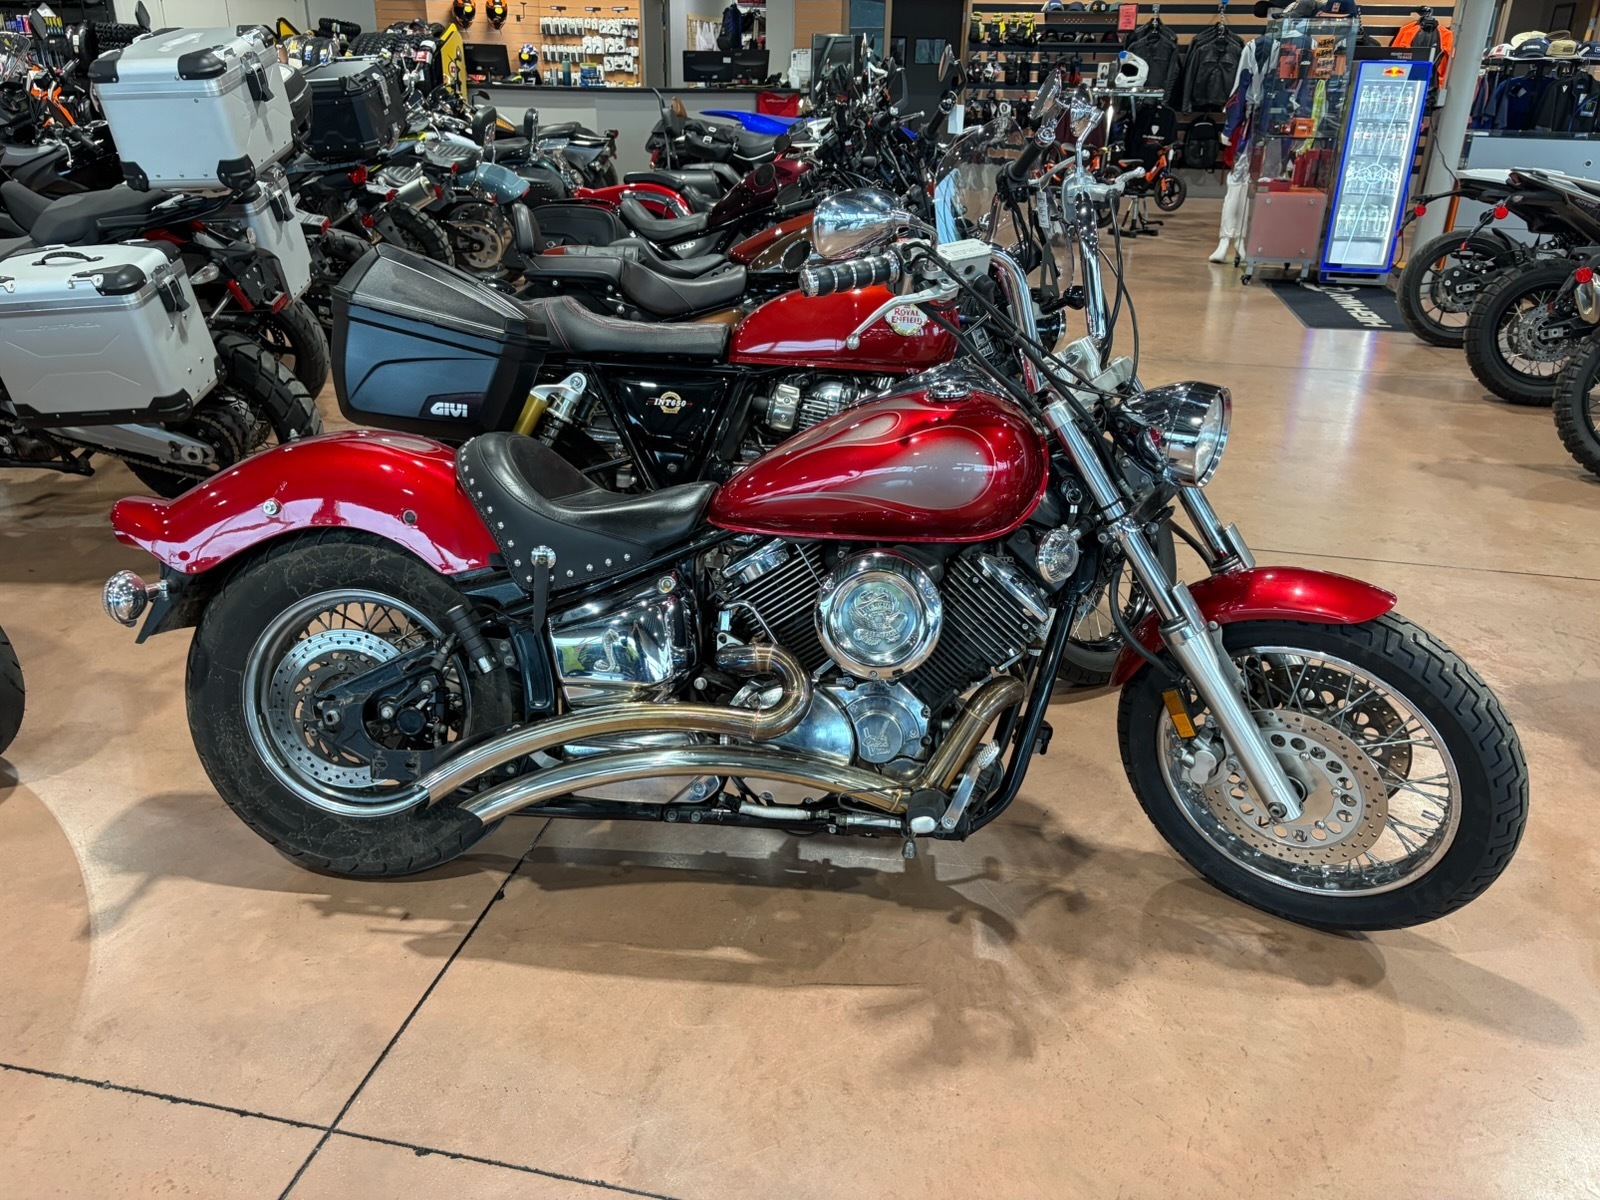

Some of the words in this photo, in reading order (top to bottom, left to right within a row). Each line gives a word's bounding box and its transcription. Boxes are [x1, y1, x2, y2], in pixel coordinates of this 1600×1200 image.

[894, 308, 920, 316] ROYAL
[1325, 291, 1392, 328] HIGHWAY
[891, 316, 923, 325] ENFIELD
[654, 398, 687, 407] INT650
[430, 401, 468, 418] GIVI
